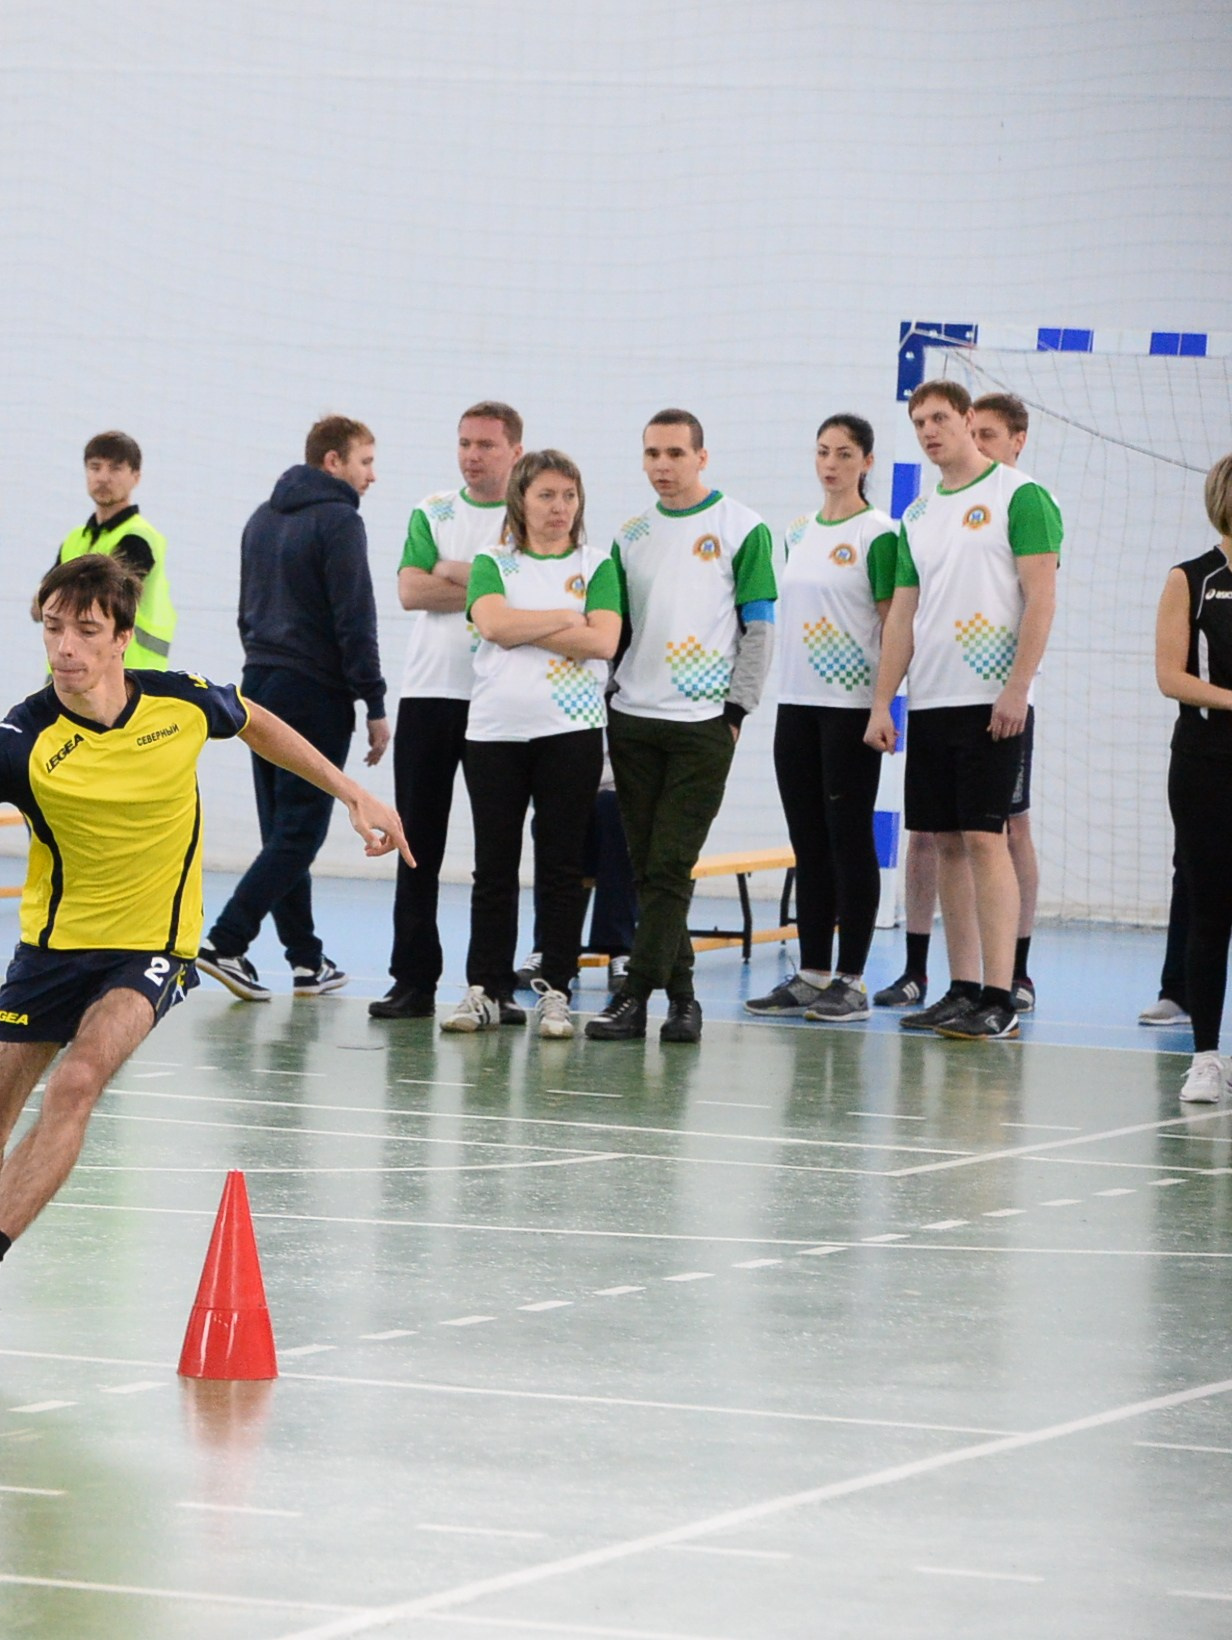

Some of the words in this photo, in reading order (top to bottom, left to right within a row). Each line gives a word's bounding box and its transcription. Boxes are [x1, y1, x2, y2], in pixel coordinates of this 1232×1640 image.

[136, 723, 180, 747] СЕВЕРНЫЙ
[45, 733, 85, 774] LEGEA
[144, 956, 170, 987] 2
